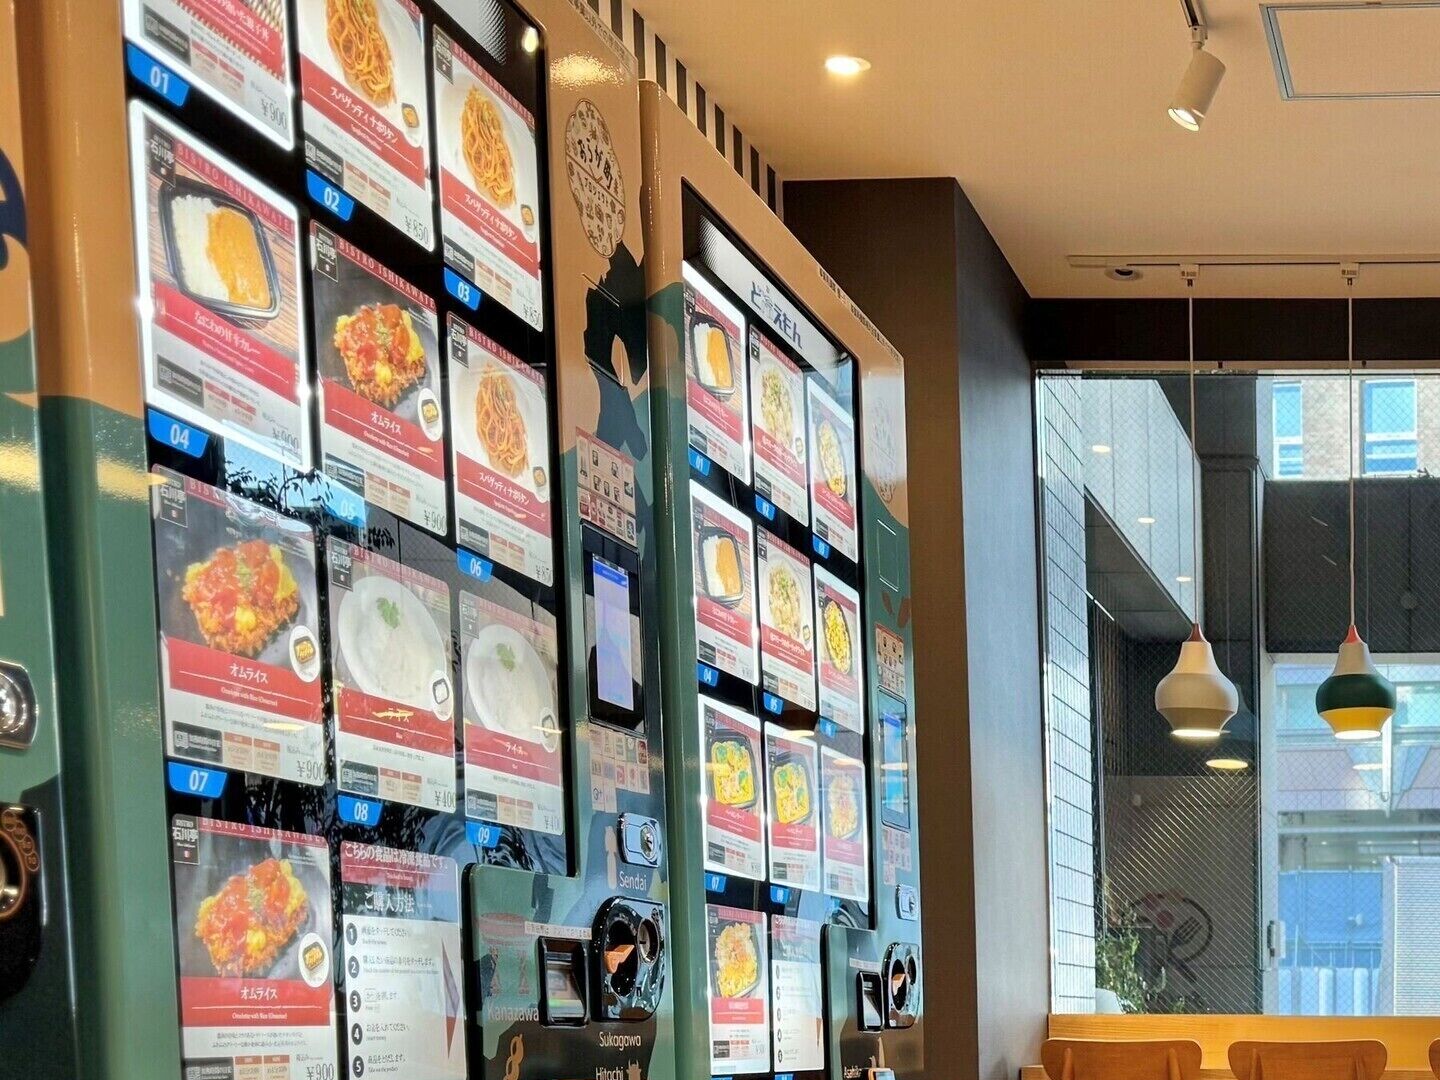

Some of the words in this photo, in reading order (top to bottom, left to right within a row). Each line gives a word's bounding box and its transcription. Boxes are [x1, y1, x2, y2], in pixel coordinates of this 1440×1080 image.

[150, 66, 170, 94] 01
[261, 98, 288, 130] ¥900
[324, 187, 341, 212] 02
[405, 216, 429, 245] ¥850
[337, 237, 374, 269] BISTRO
[457, 281, 470, 302] 03
[370, 411, 402, 435] オムライス
[170, 423, 190, 450] 04
[341, 501, 355, 520] 05
[470, 558, 482, 577] 06
[229, 663, 269, 684] オムライス
[189, 770, 209, 792] 07
[296, 760, 325, 782] ¥900
[354, 801, 369, 821] 08
[172, 826, 199, 842] 石川亭
[478, 828, 490, 844] 09
[619, 871, 647, 891] Sendai
[364, 890, 415, 913] ご購入方法
[351, 961, 357, 974] 2
[240, 986, 279, 1001] オムライス
[353, 995, 358, 1008] 3
[487, 1004, 540, 1022] Kanazawa
[354, 1028, 359, 1041] 4
[599, 1031, 642, 1051] Sukagawa
